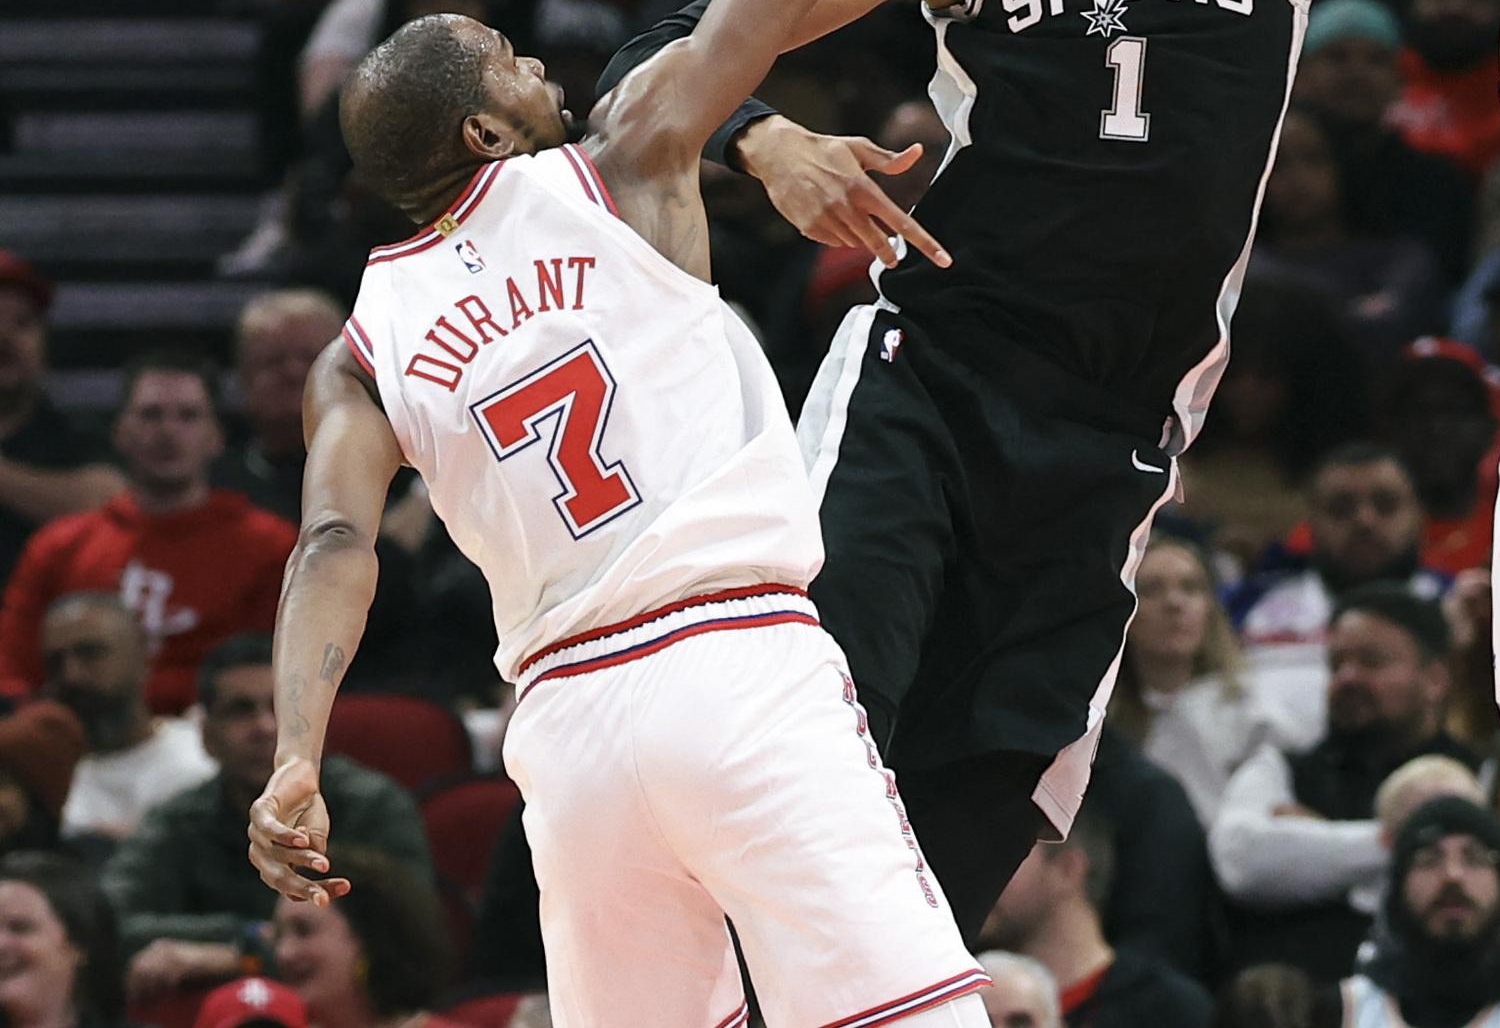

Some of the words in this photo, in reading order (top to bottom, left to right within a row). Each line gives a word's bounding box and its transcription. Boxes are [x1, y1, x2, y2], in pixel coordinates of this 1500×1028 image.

[1098, 36, 1151, 142] 1
[405, 256, 596, 393] DURANT
[469, 338, 643, 541] 7
